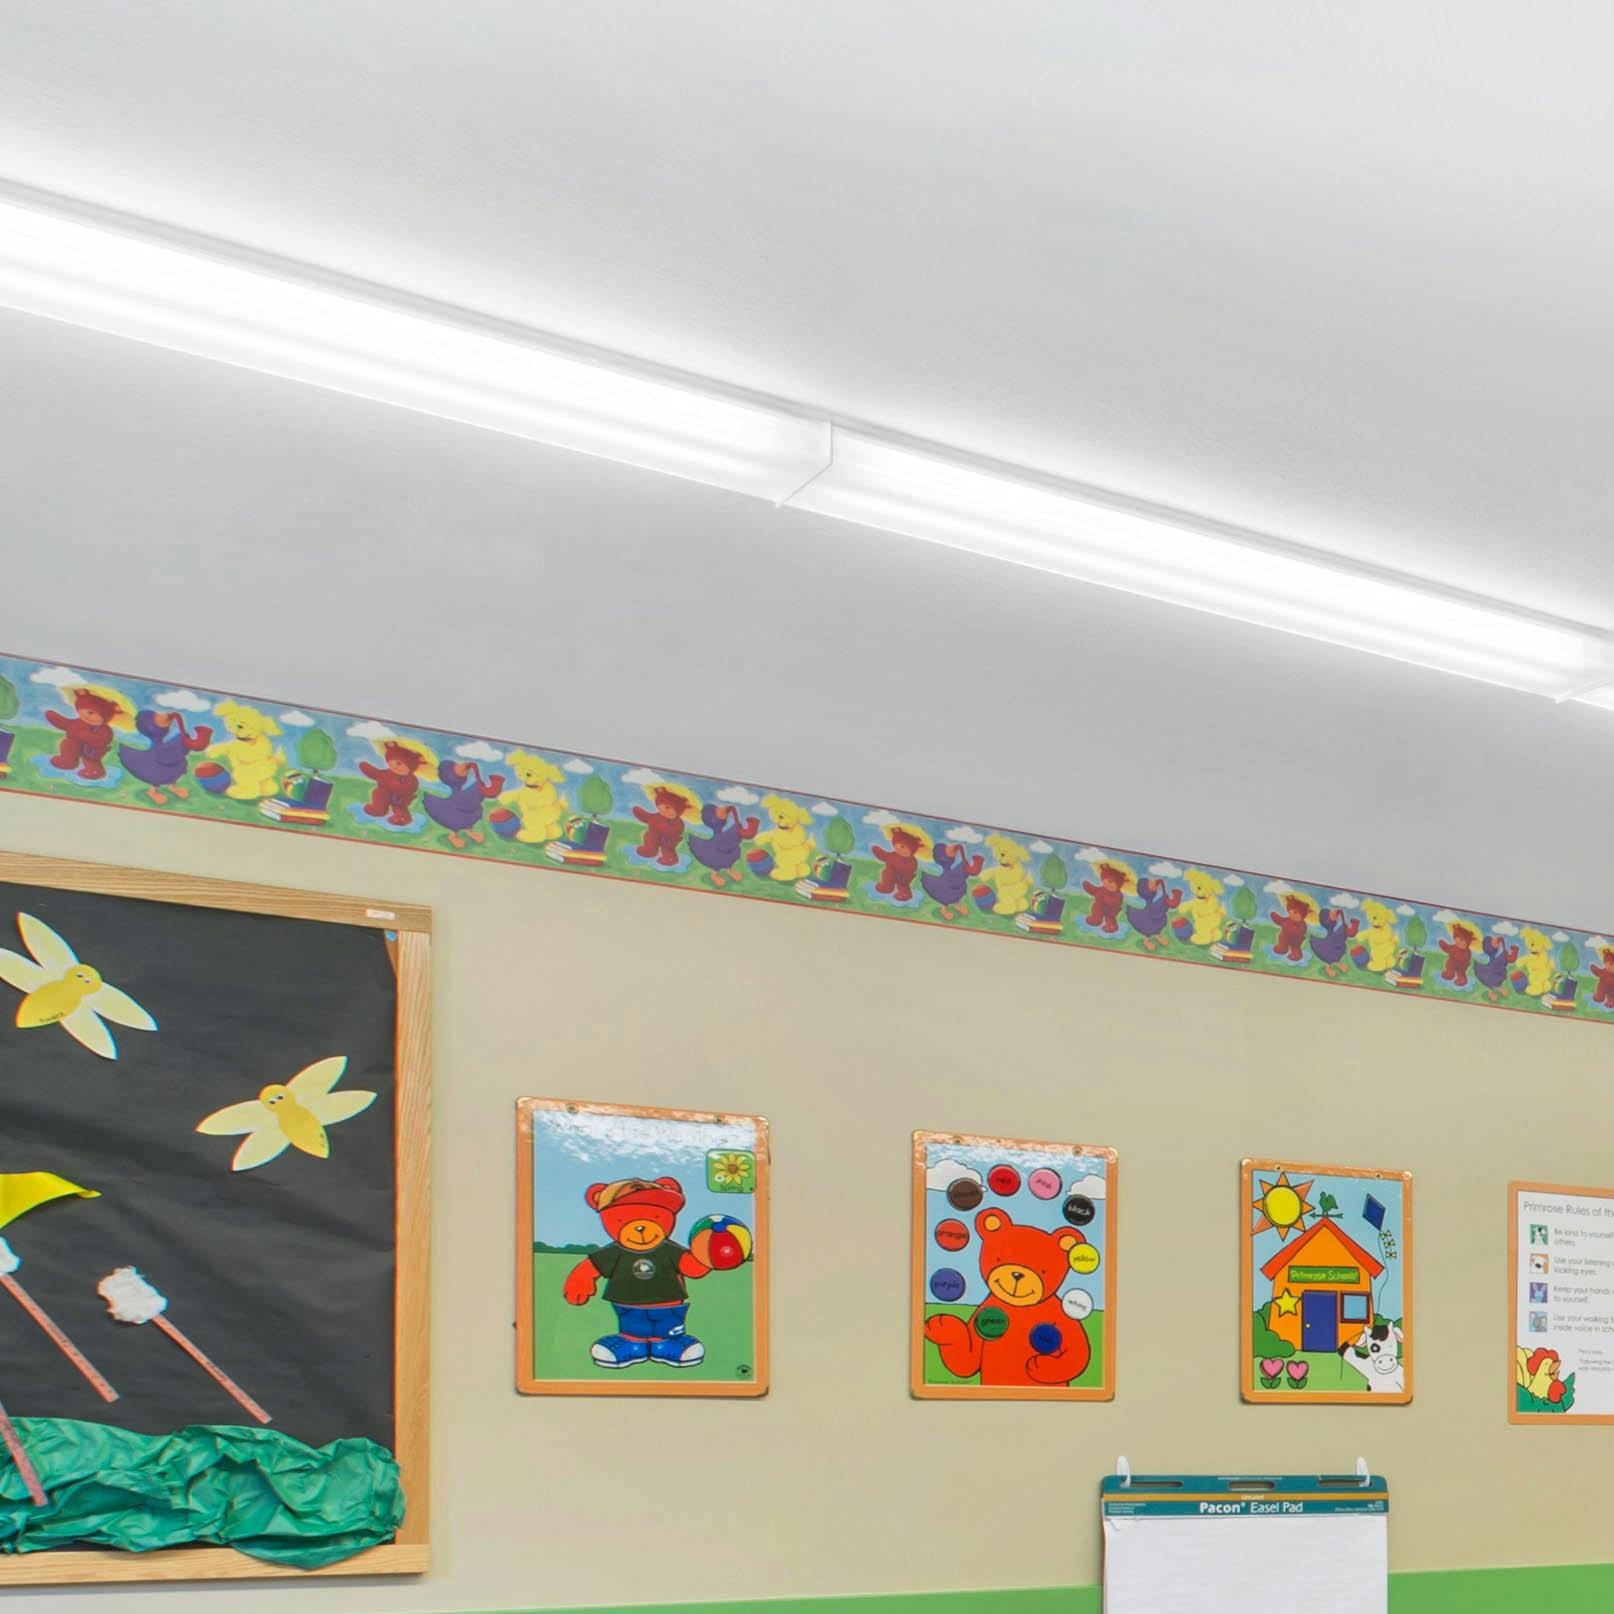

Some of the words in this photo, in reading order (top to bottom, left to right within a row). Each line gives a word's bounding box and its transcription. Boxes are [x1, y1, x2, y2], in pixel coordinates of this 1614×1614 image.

[1067, 1203, 1091, 1217] black
[1523, 1201, 1564, 1215] Primrose
[1566, 1204, 1590, 1217] Rules
[1592, 1207, 1602, 1217] of
[1589, 1231, 1614, 1240] yourself
[1554, 1256, 1565, 1264] Use
[1567, 1257, 1583, 1267] your
[1250, 1502, 1280, 1514] Easel
[1282, 1502, 1303, 1513] Pad
